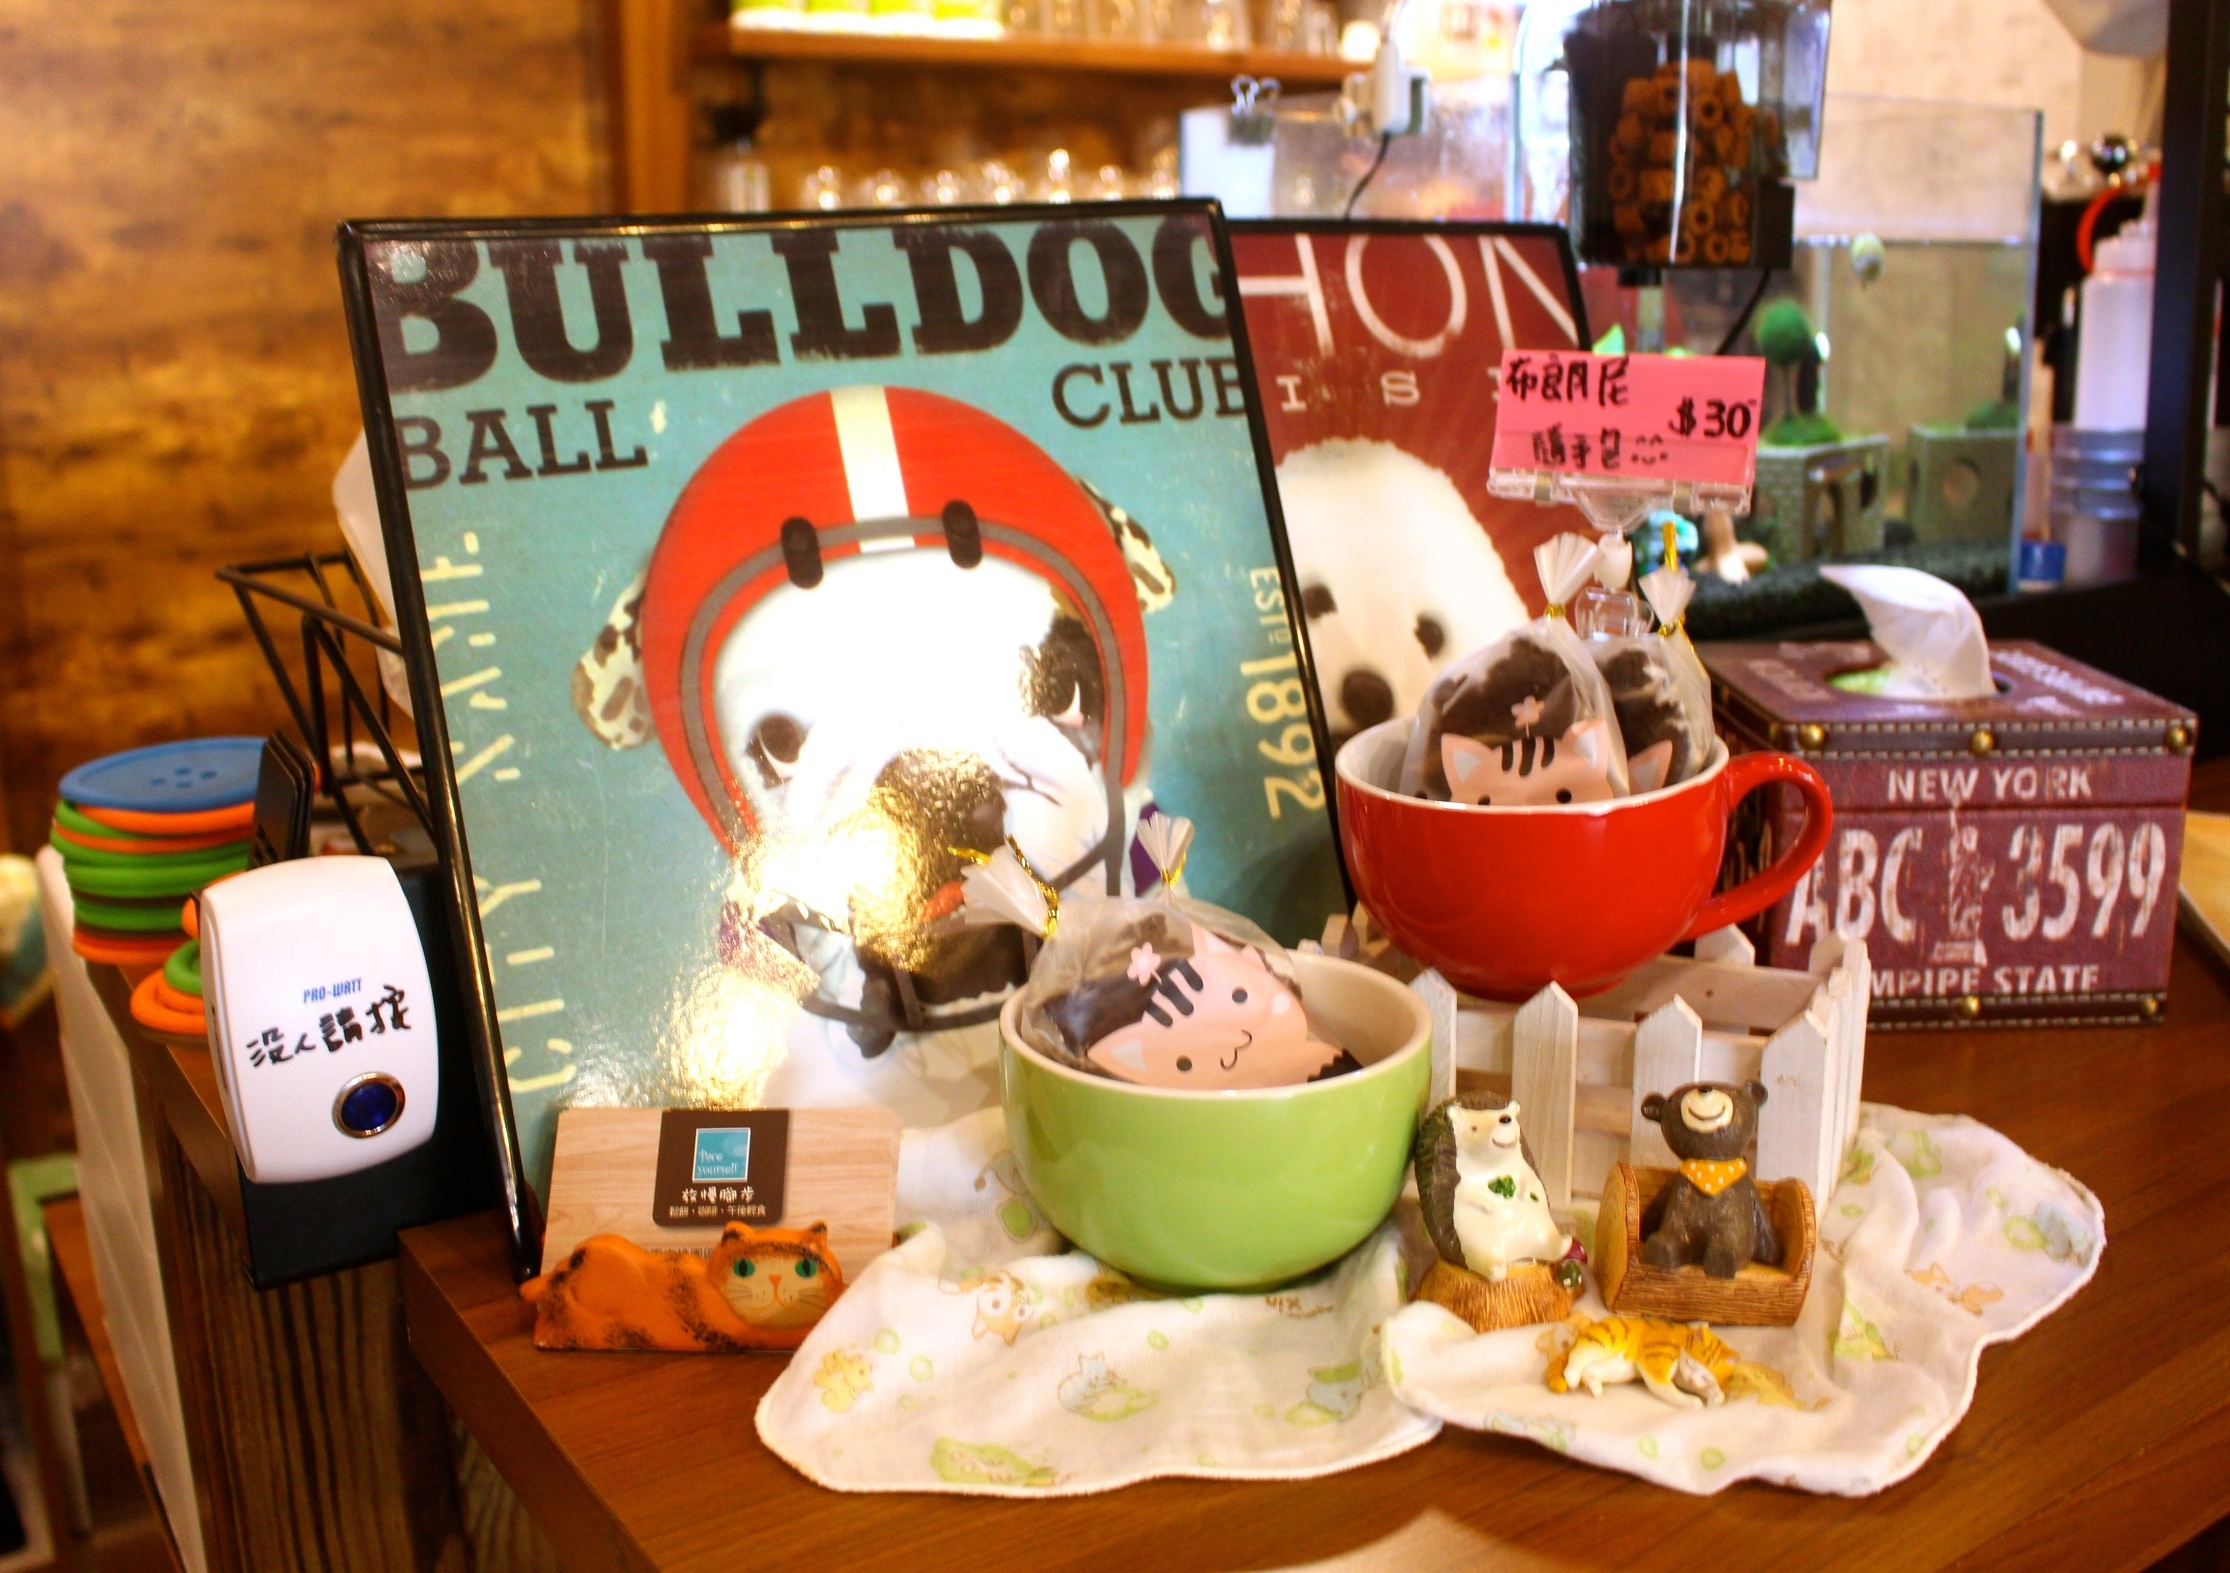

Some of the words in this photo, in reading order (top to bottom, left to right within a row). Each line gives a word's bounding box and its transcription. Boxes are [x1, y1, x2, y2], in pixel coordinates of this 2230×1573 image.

[364, 215, 1229, 393] BULLDOG
[1505, 353, 1629, 407] 布朗尼
[394, 399, 649, 491] BALL
[1240, 650, 1326, 819] 1892
[1886, 767, 1979, 801] NEW
[1992, 766, 2092, 800] YORK
[1785, 827, 1923, 946] ABC
[2002, 822, 2167, 942] 3599
[303, 977, 362, 1004] PRO-WATT
[1993, 964, 2100, 995] STATE
